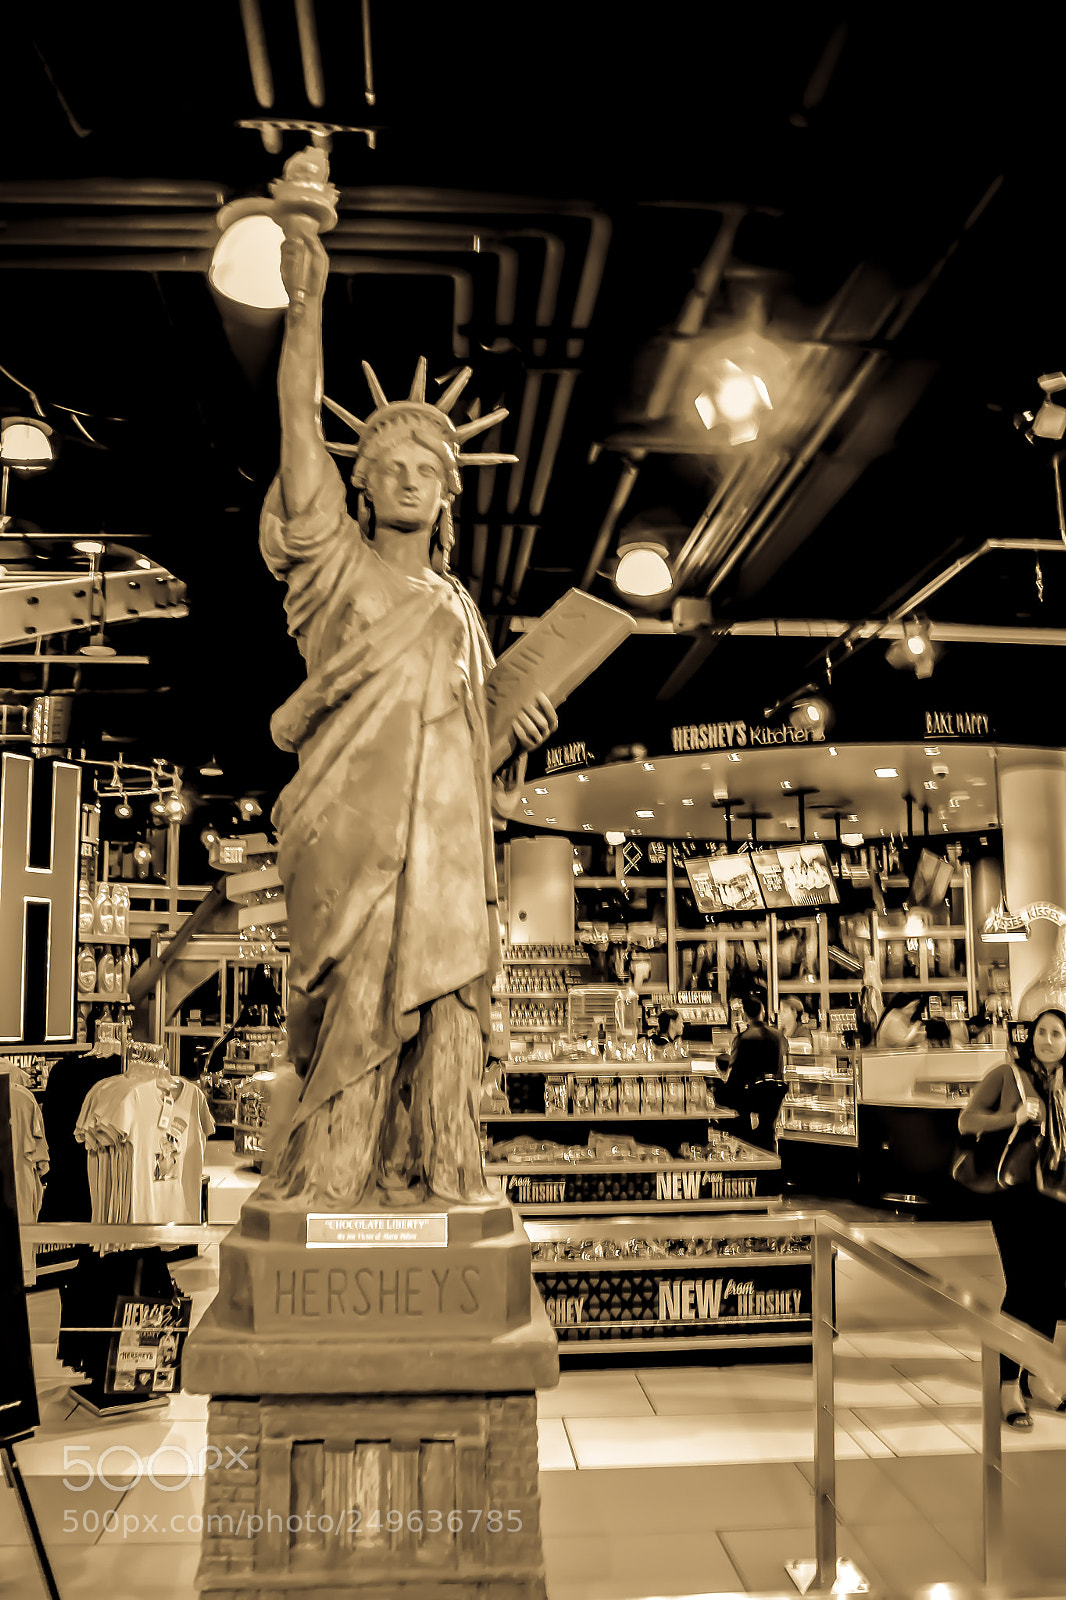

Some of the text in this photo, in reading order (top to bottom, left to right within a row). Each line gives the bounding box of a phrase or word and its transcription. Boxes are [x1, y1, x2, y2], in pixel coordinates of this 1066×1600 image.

[924, 711, 988, 734] BAKE HAPPY
[1027, 905, 1060, 922] KISSES
[518, 1182, 566, 1203] HERSHEY
[656, 1171, 701, 1200] NEW
[712, 1178, 757, 1199] HERSHEY
[545, 1297, 584, 1325] SHEY
[659, 1278, 801, 1321] NEW from HERSHEY
